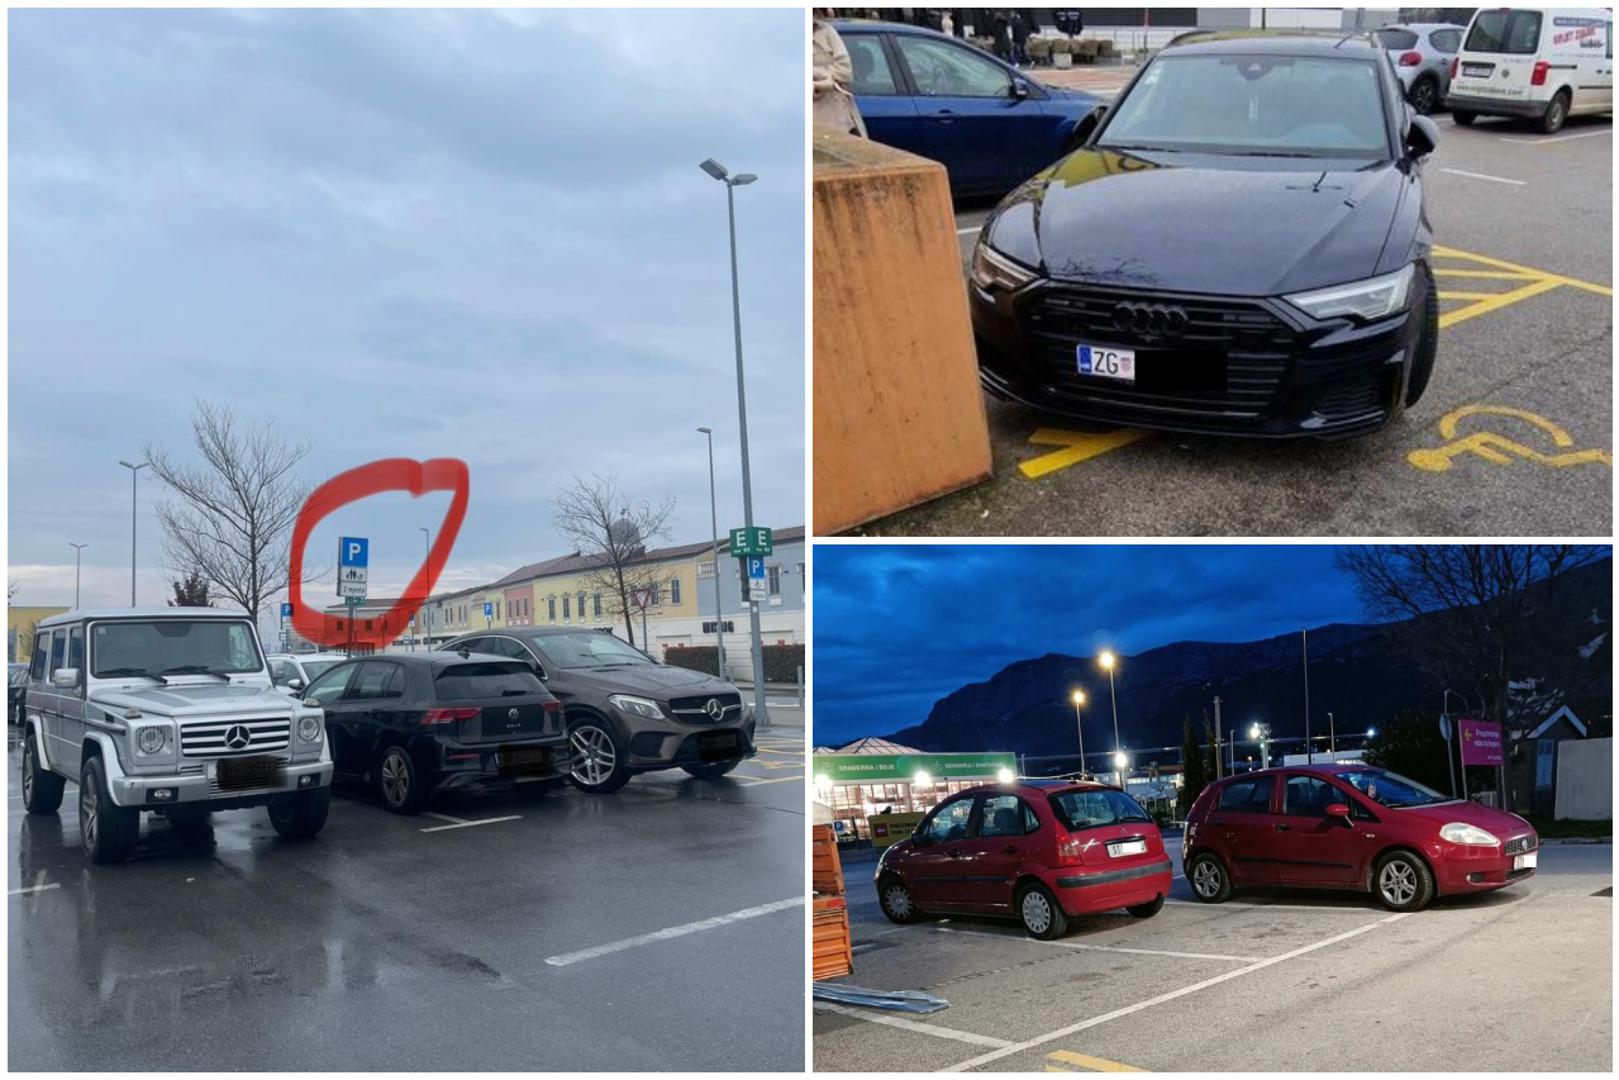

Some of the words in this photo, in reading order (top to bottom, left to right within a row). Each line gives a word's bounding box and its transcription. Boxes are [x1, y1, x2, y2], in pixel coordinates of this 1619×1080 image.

[1094, 351, 1119, 375] ZG
[736, 531, 747, 547] E
[757, 530, 768, 546] E
[349, 542, 361, 561] P
[752, 560, 761, 574] P
